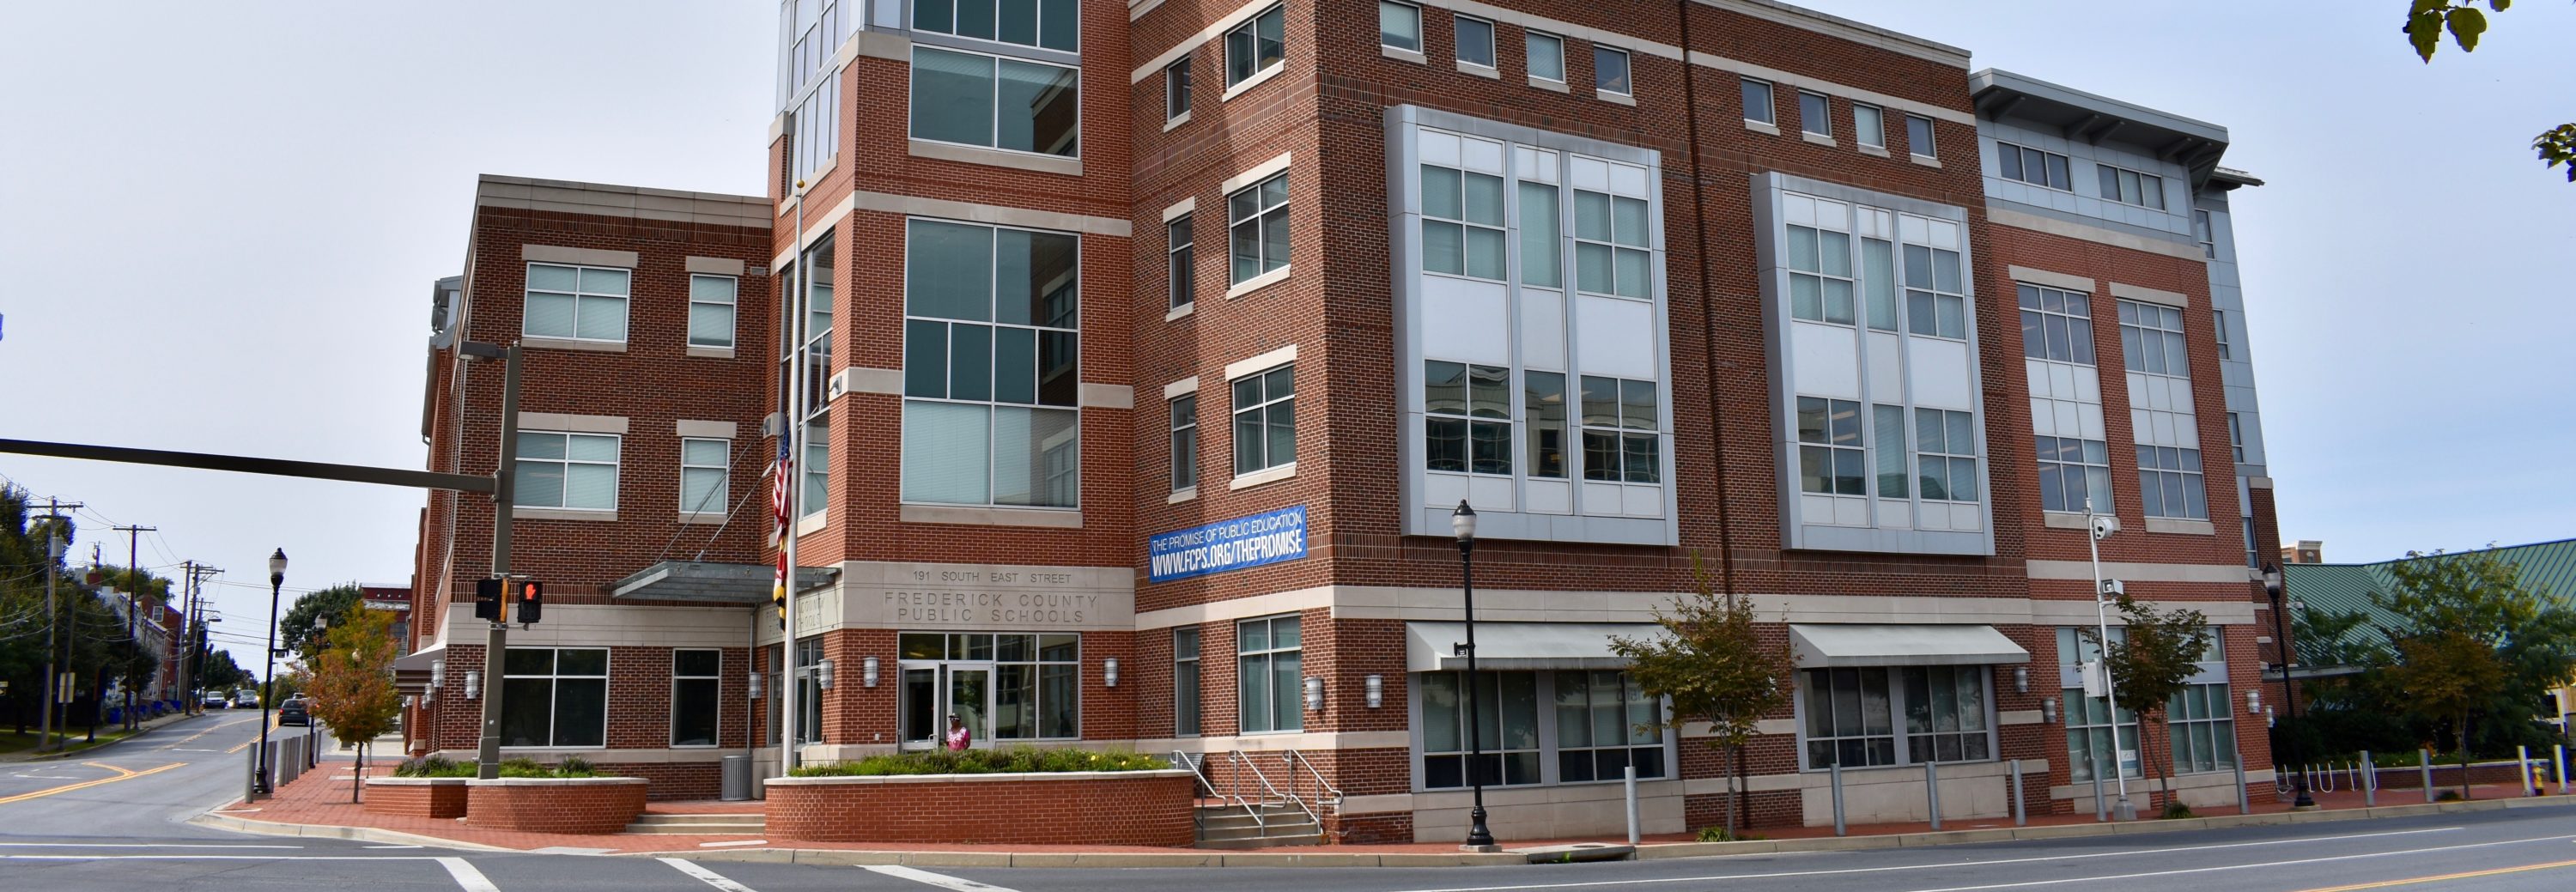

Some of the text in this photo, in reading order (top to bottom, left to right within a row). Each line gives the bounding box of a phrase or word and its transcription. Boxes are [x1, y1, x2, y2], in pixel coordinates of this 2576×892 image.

[1153, 512, 1302, 552] THE PROMISE OF PUBLIC EDUCATION
[1152, 529, 1303, 577] WWW.FCPS.ORG/THEPROMISE
[914, 571, 1072, 584] 191 SOUTH EAST STREET
[884, 592, 1097, 609] FREDERICK COUNTY
[898, 608, 1084, 622] PUBLIC SCHOOLS
